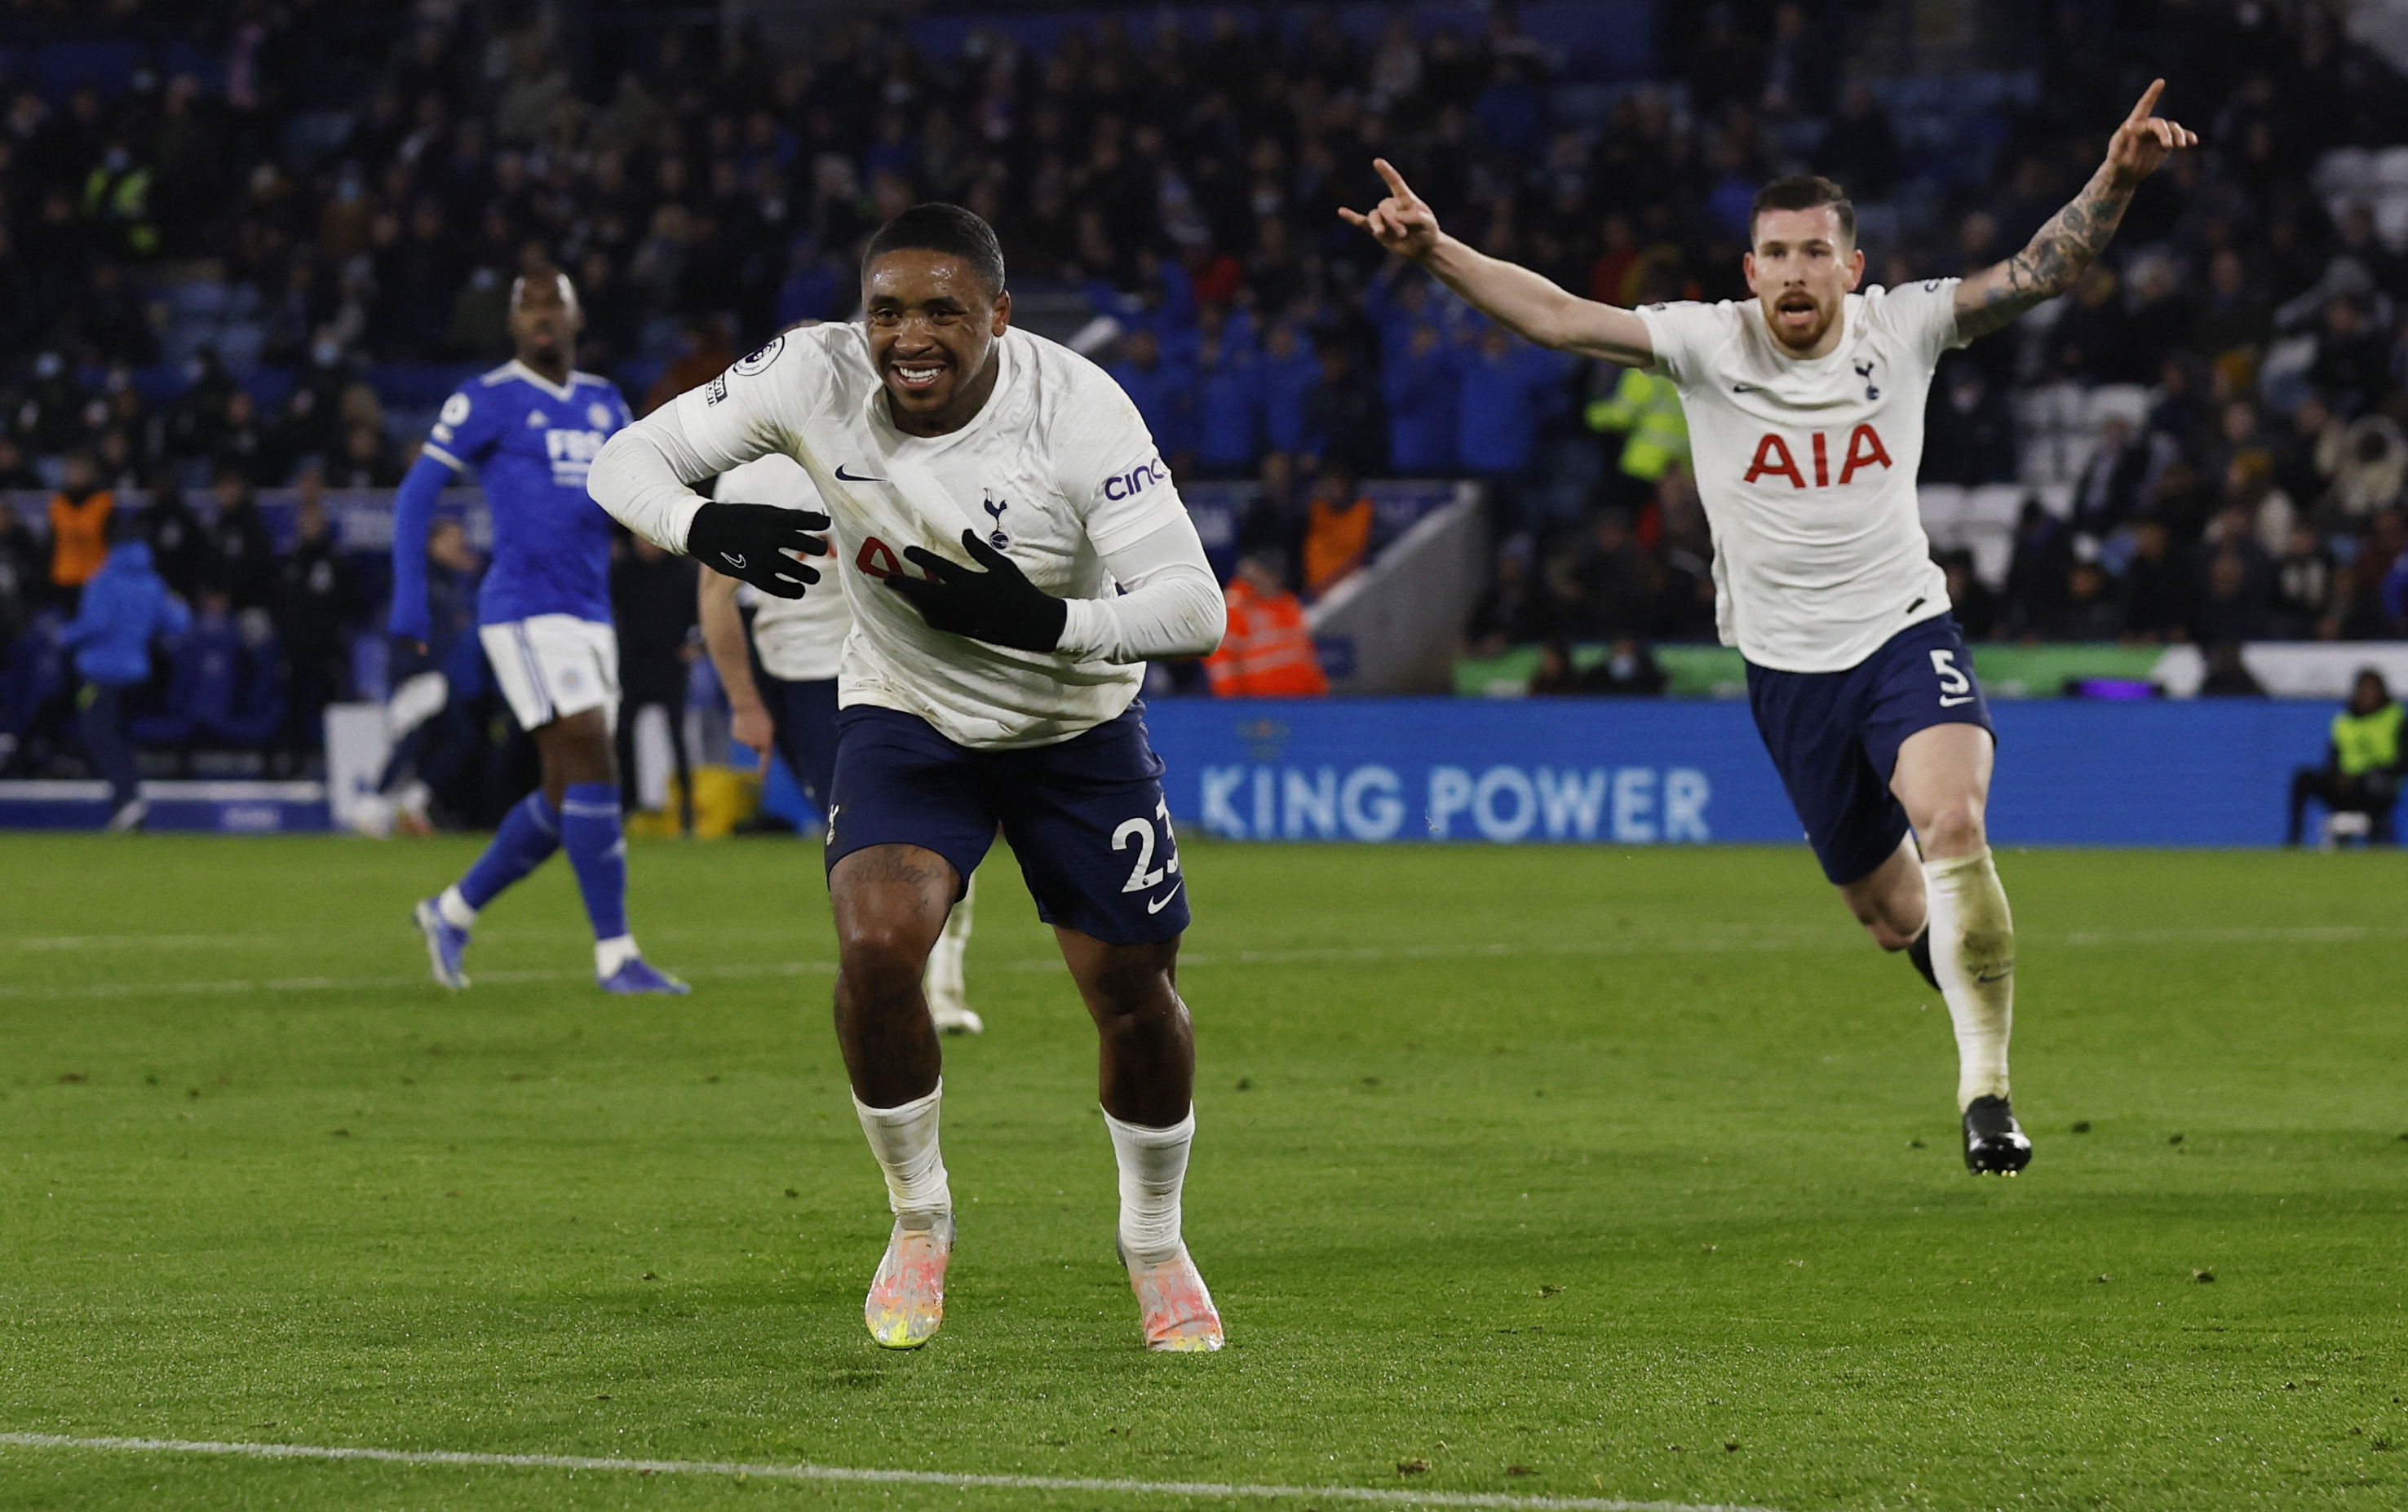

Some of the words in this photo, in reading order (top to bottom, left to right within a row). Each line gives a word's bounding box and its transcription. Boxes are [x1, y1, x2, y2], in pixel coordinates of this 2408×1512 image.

[1743, 423, 1892, 489] AIA
[1929, 649, 1970, 695] 5
[1201, 764, 1404, 842] KING
[1429, 764, 1711, 843] POWER
